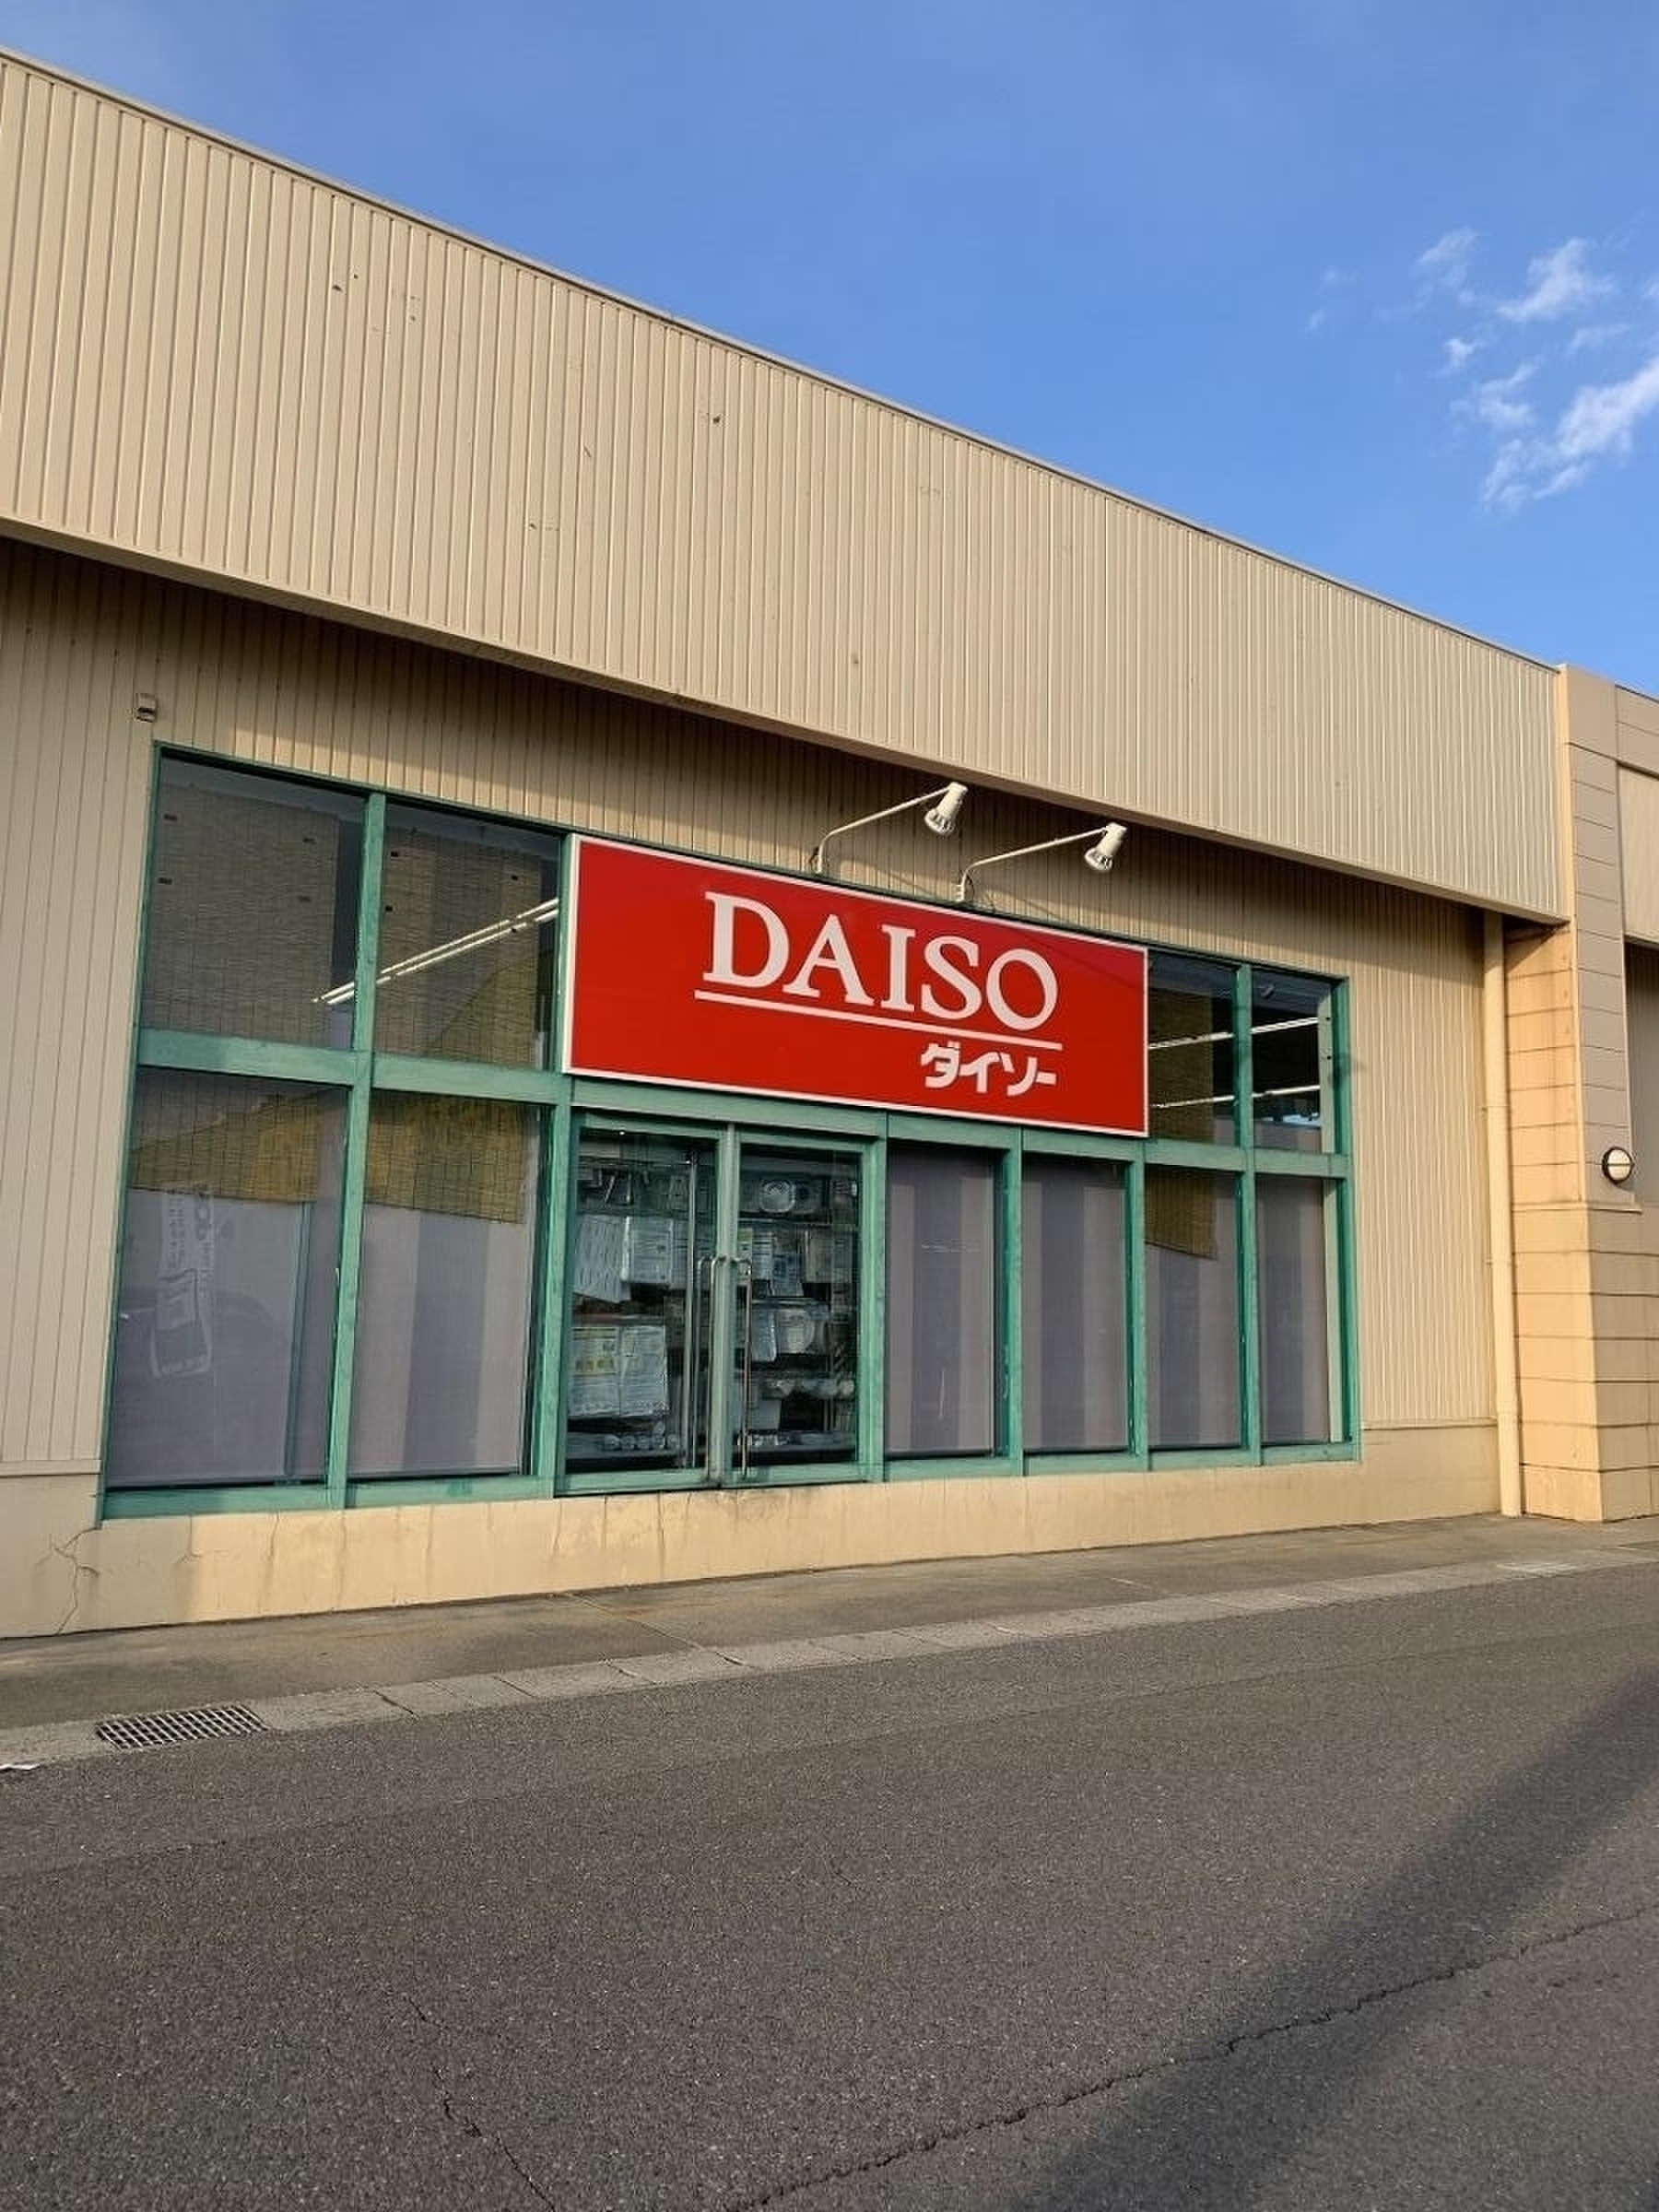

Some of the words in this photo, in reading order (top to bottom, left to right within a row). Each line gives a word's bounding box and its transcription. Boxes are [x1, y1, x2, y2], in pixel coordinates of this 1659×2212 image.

[702, 890, 1058, 1030] DAISO
[920, 1041, 1057, 1097] ダイソー
